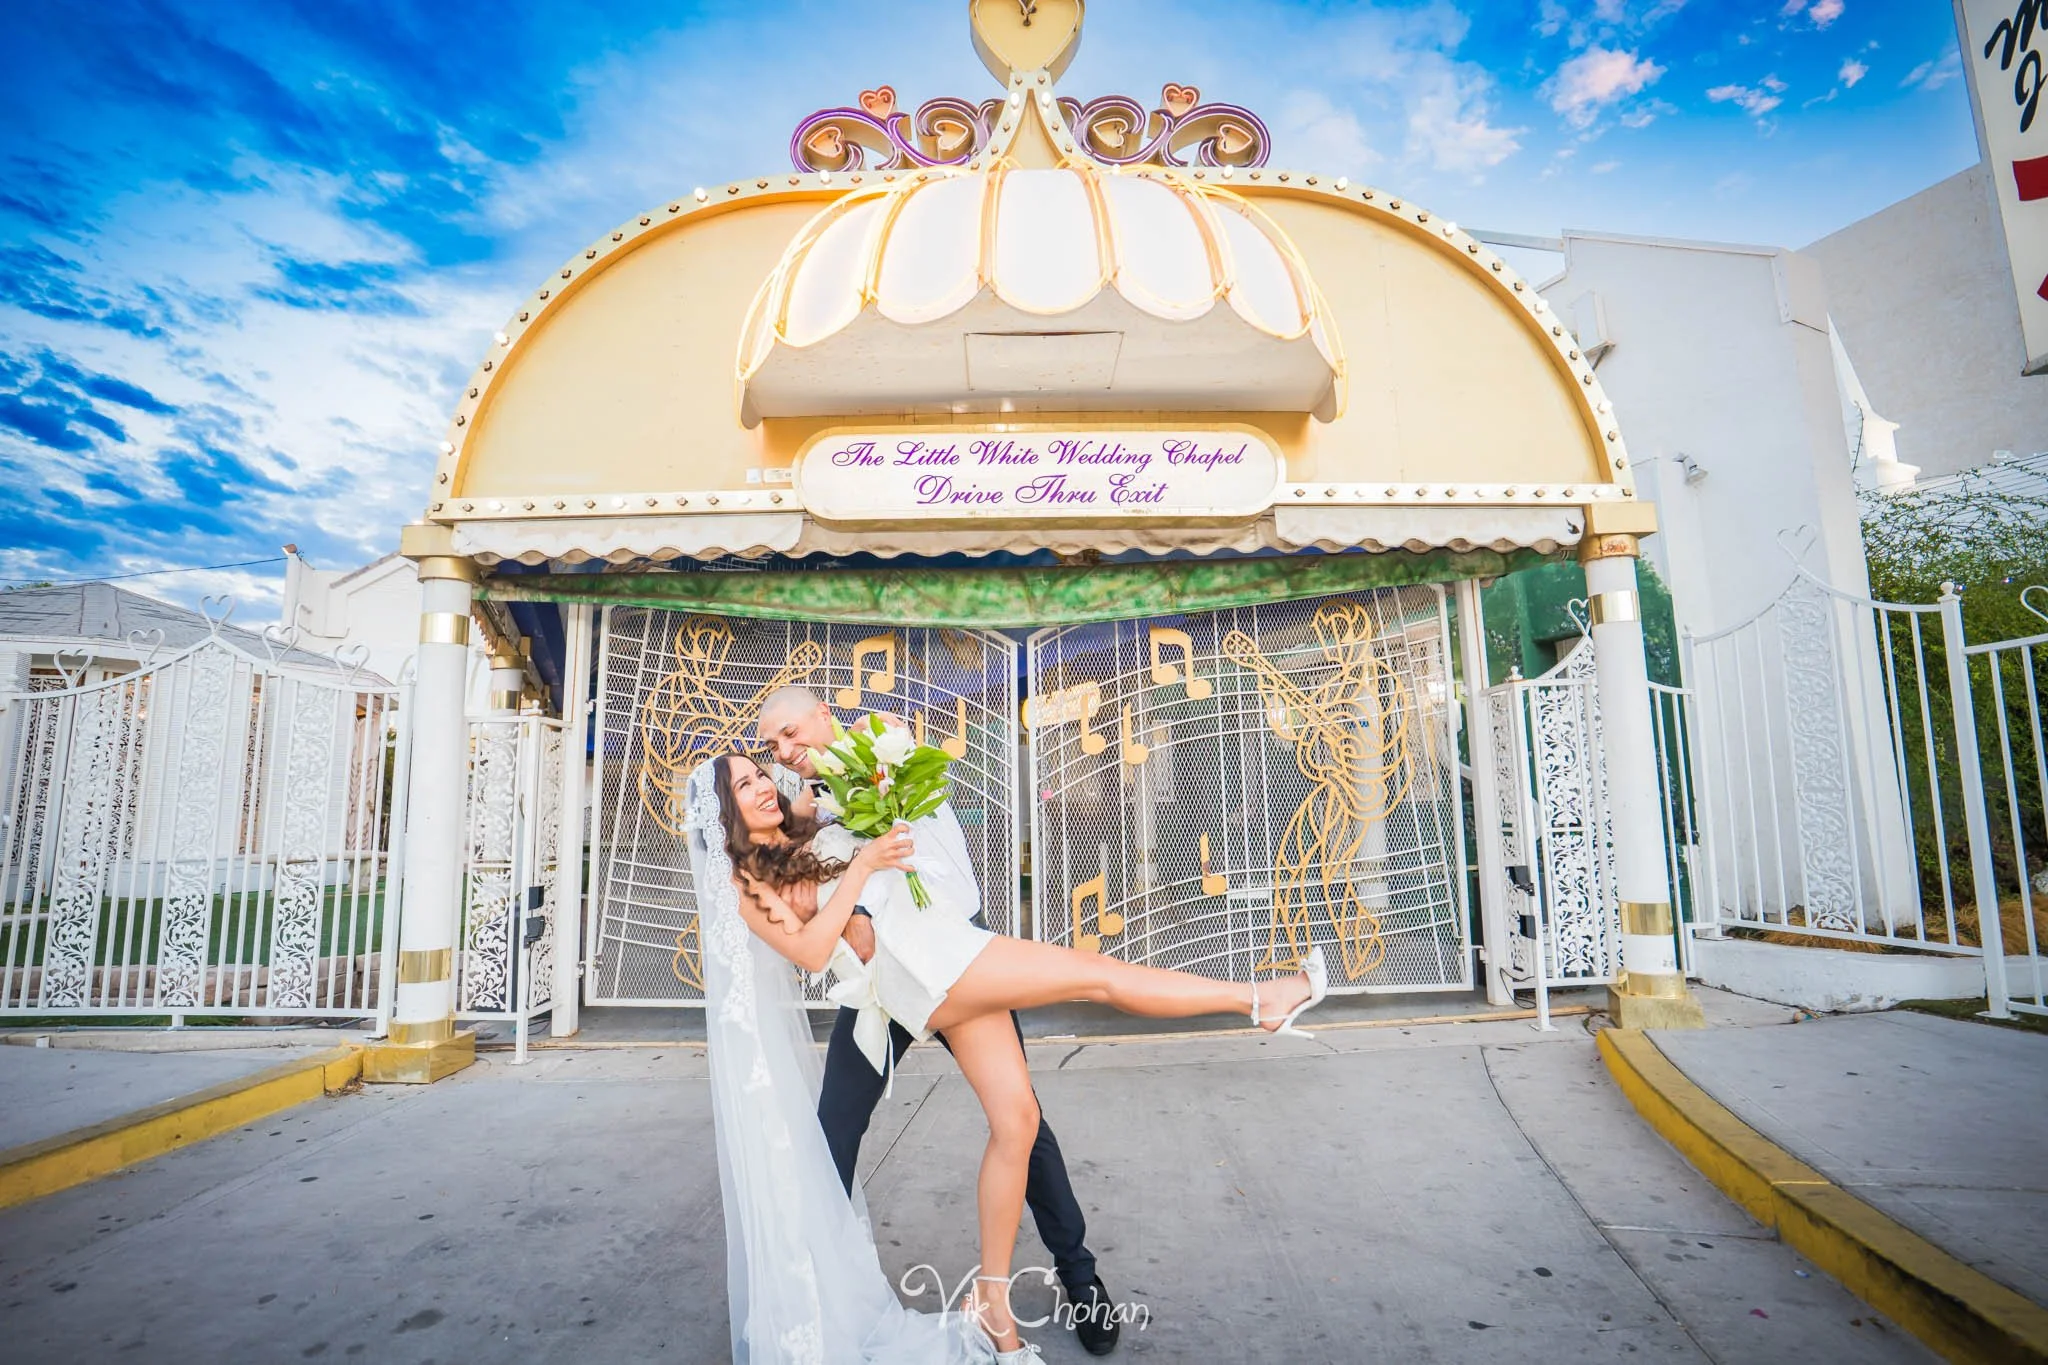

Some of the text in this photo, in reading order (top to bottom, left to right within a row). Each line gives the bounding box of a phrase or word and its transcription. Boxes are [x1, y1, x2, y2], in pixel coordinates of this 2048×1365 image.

[832, 439, 1248, 473] The Little White Wedding Chapel
[914, 473, 1169, 506] Drive Thru Exit
